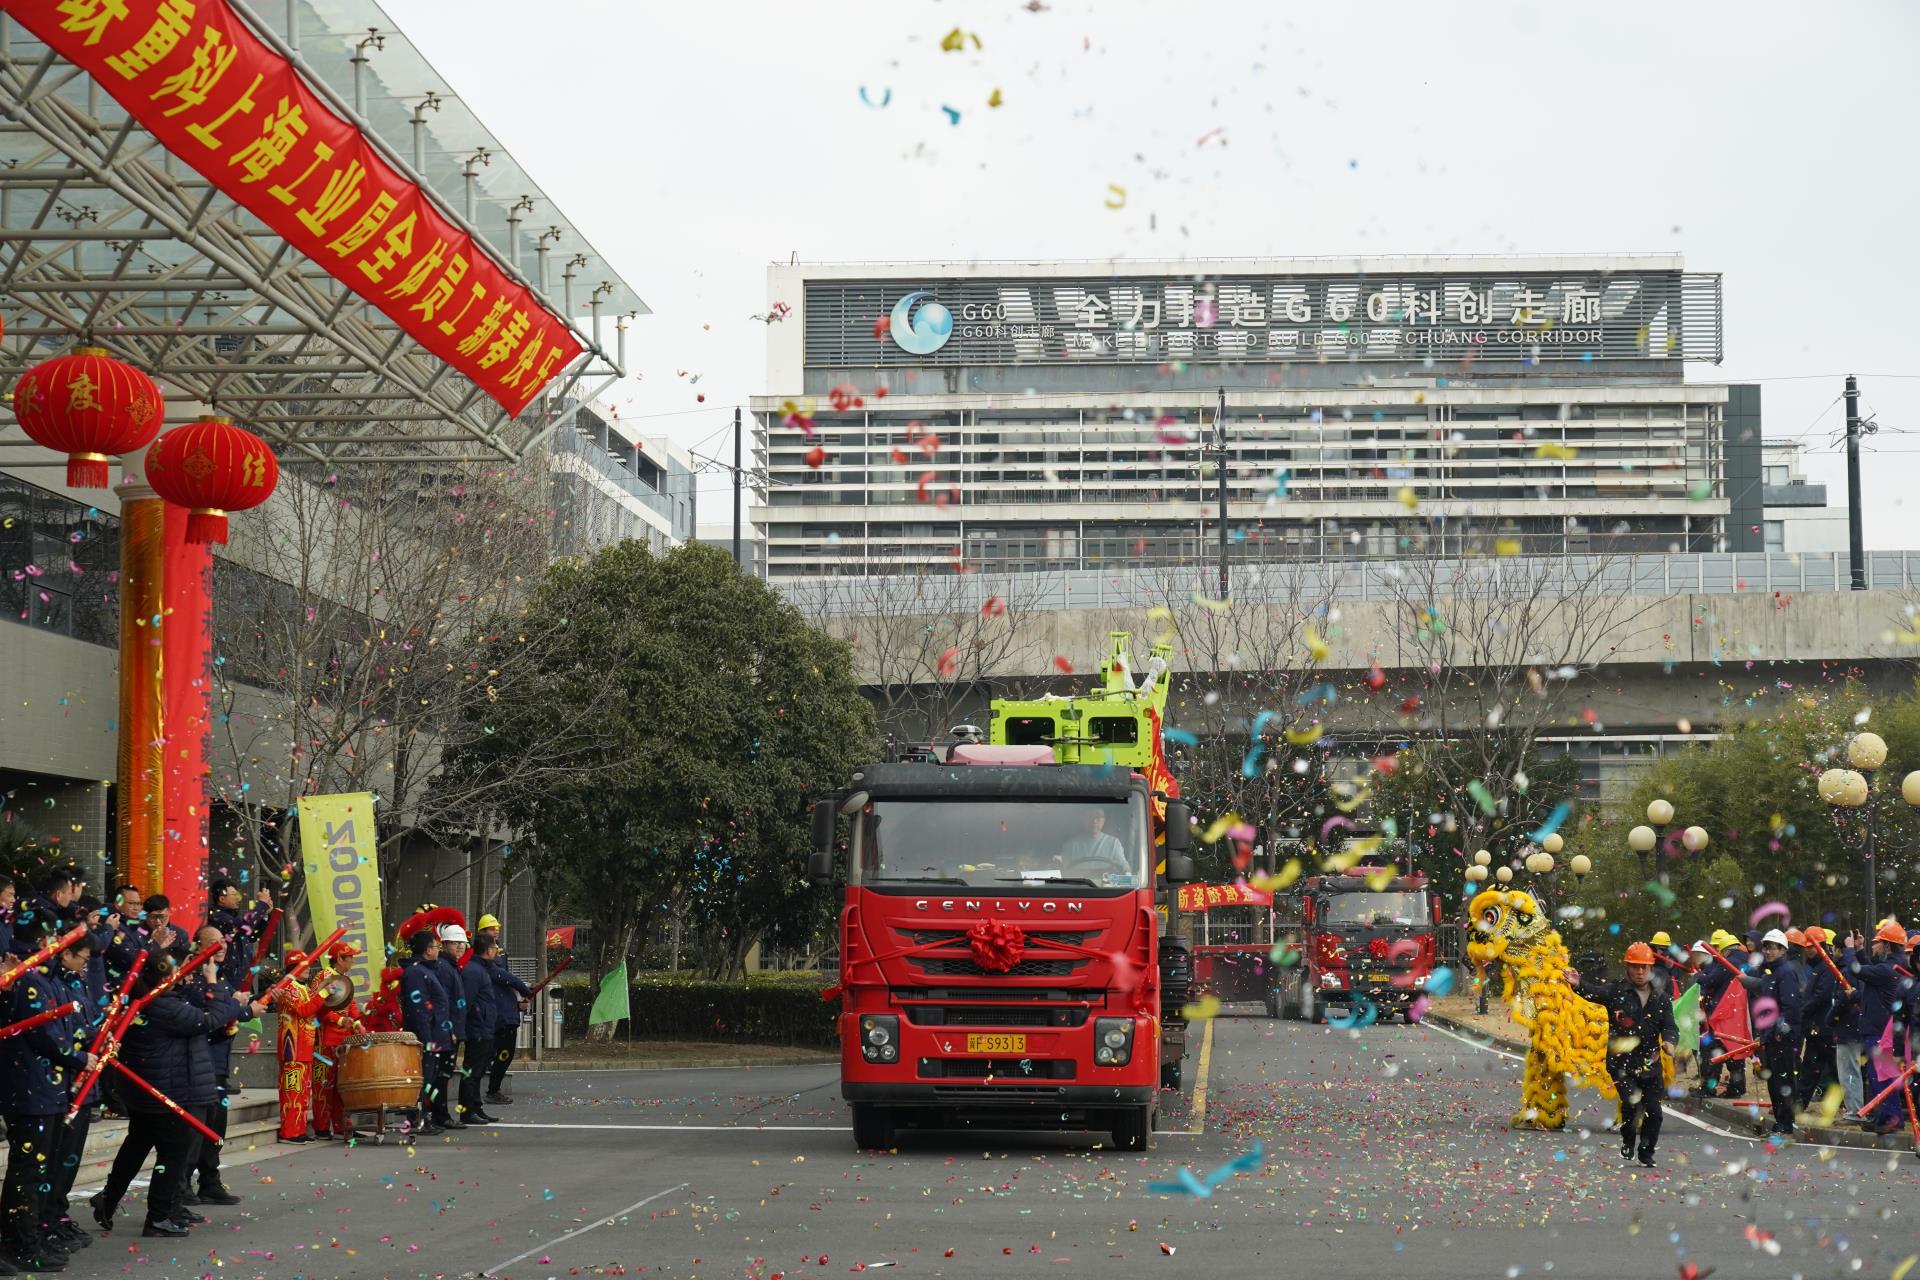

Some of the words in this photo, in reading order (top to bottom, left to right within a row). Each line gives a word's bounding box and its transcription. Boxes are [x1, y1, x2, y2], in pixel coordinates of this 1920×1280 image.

[963, 304, 1007, 320] G60
[963, 324, 1055, 338] G60科创走廊
[1073, 334, 1129, 348] MAKE
[1135, 334, 1223, 347] EFFORTS
[1235, 333, 1258, 346] TO
[1268, 332, 1325, 347] BUILD
[1378, 330, 1488, 346] KECHUANG
[1497, 329, 1602, 344] CORRIDOR
